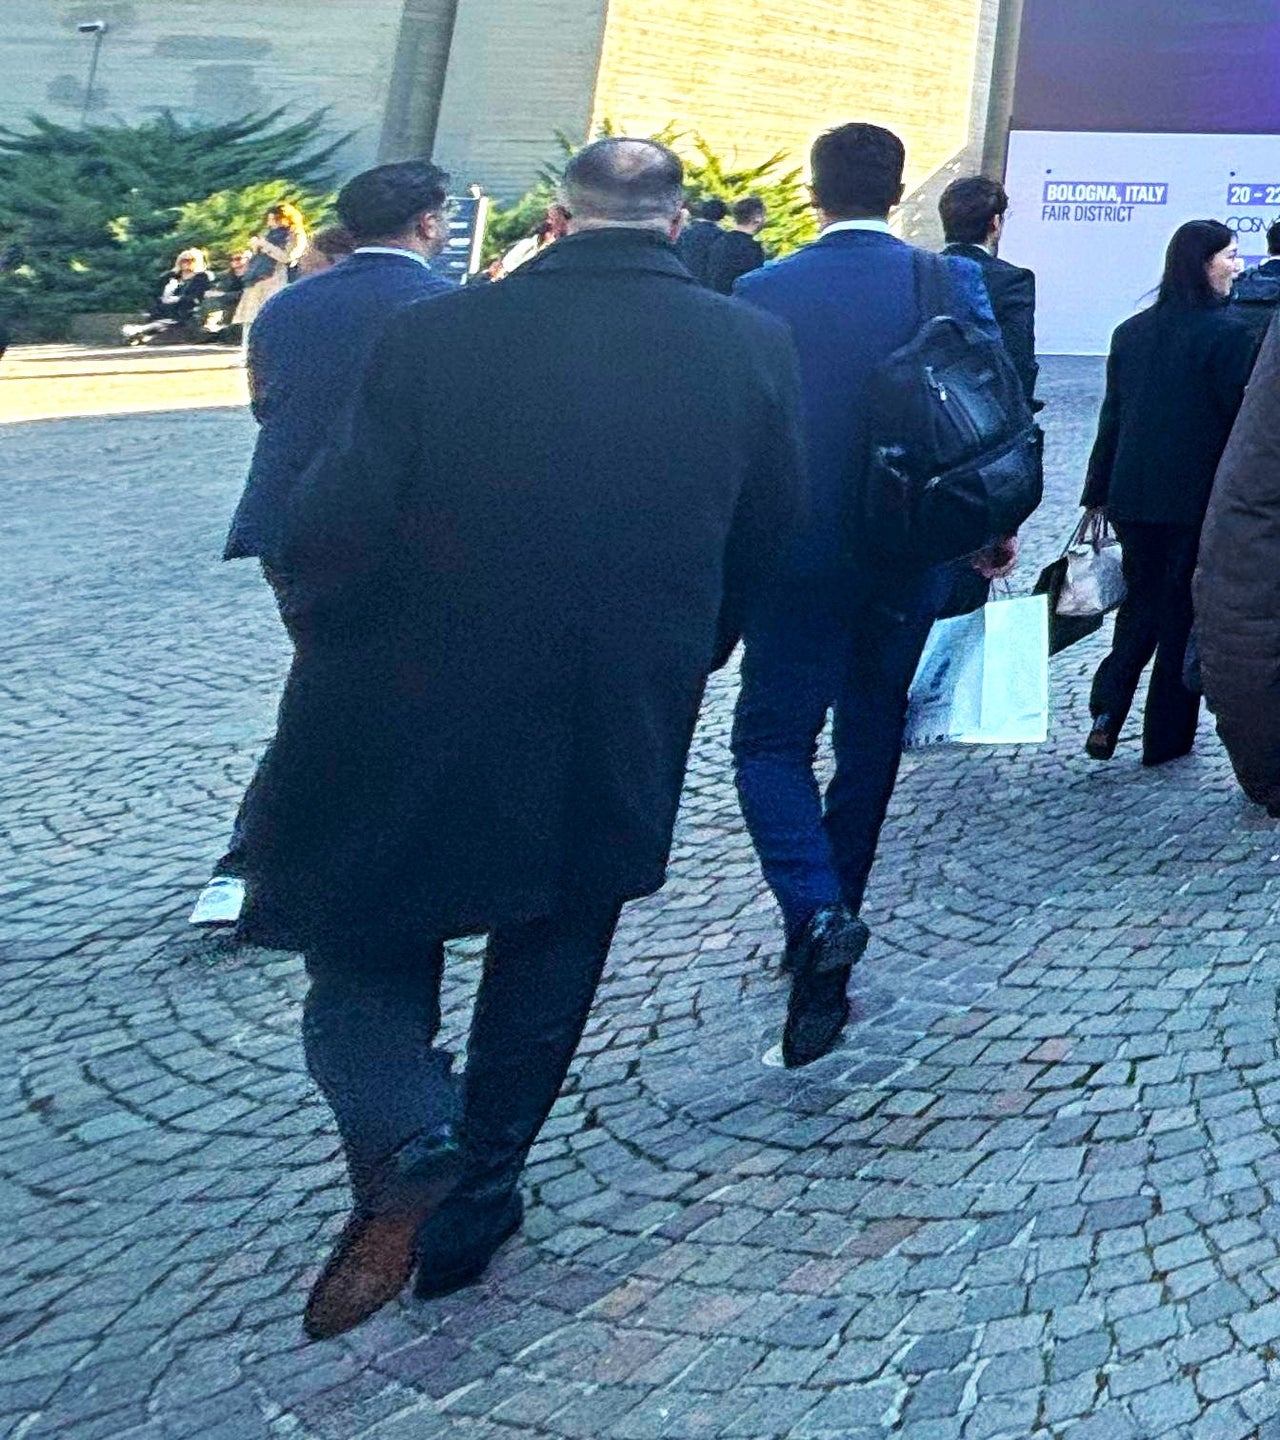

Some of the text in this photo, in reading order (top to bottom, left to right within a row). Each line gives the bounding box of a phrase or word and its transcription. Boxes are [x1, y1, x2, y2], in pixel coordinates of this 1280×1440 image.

[1046, 184, 1165, 204] BOLOGNA, ITALY
[1230, 186, 1250, 203] 20
[1042, 205, 1135, 222] FAIR DISTRICT
